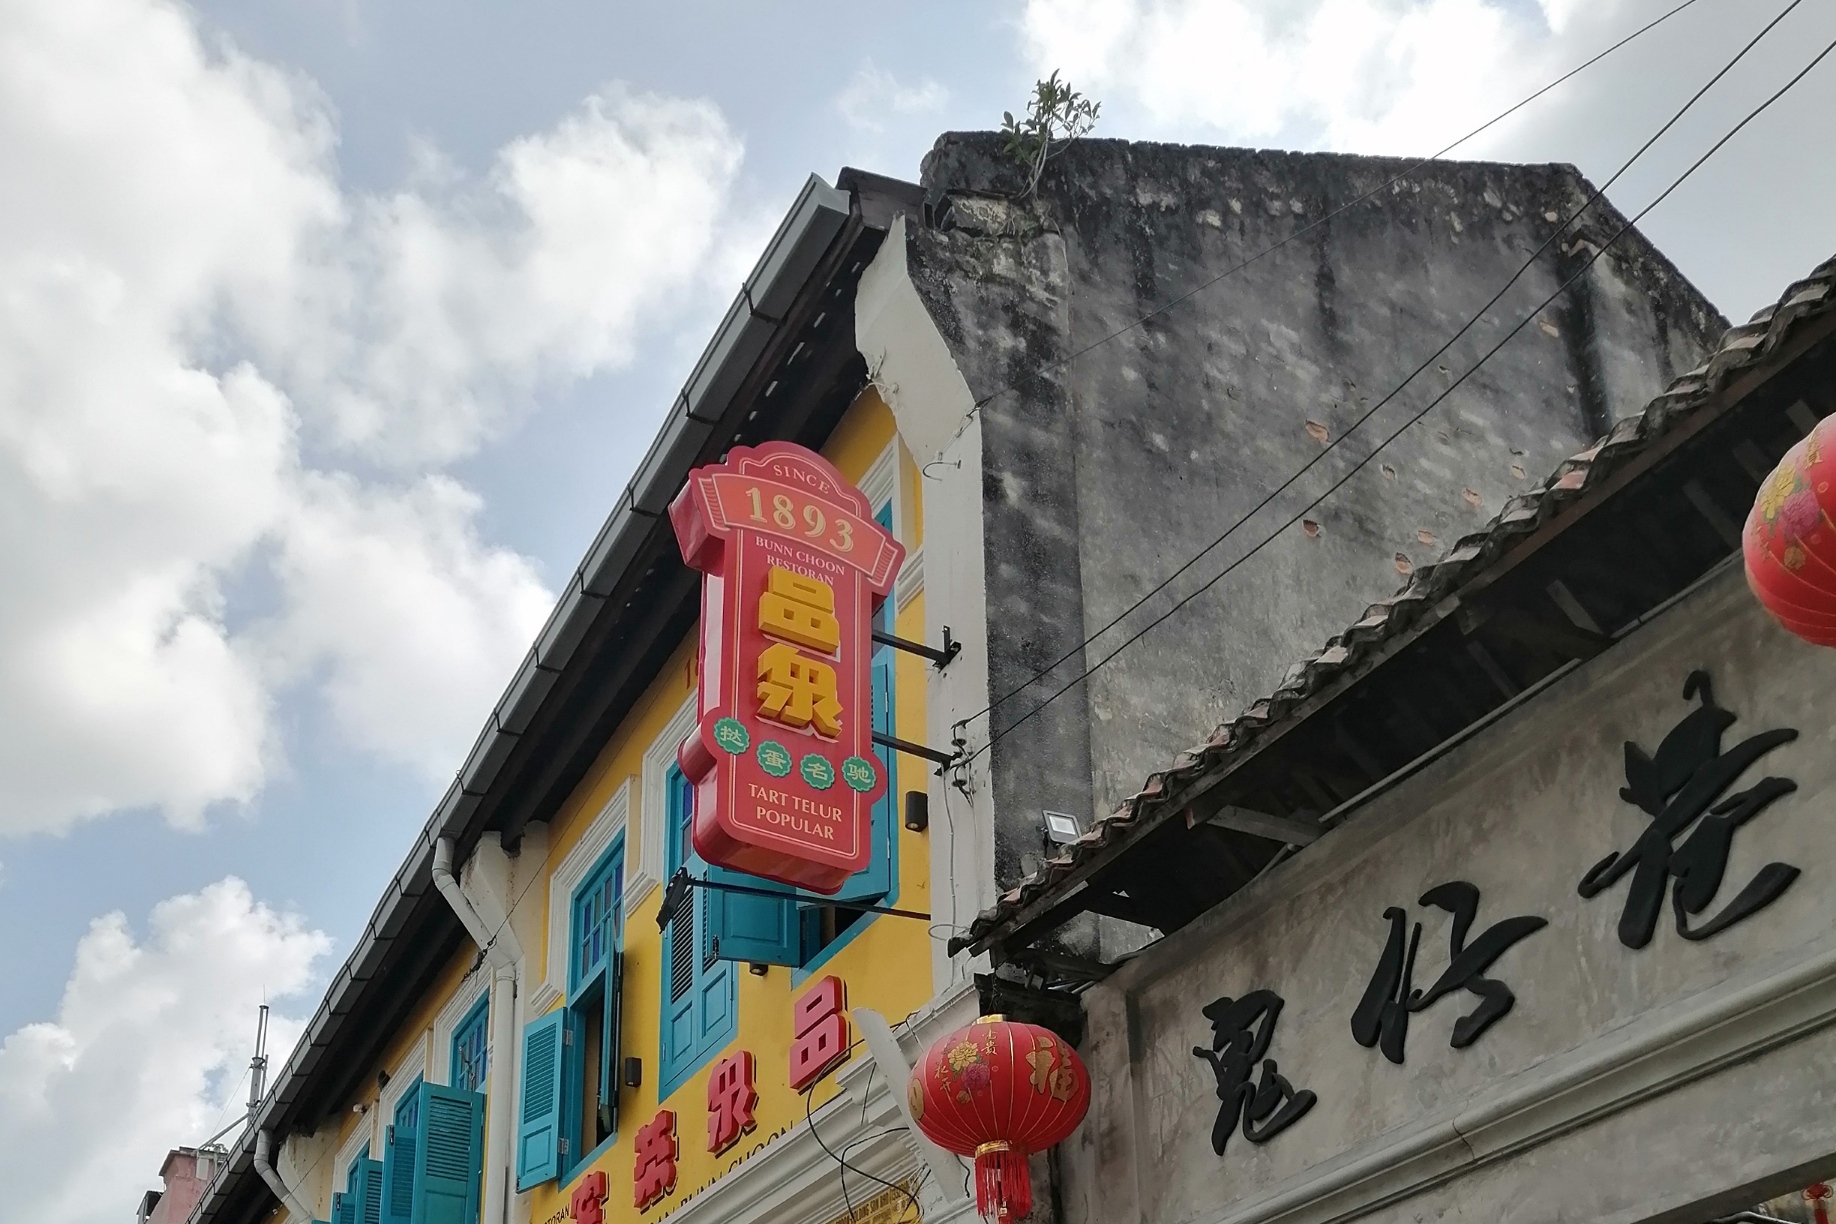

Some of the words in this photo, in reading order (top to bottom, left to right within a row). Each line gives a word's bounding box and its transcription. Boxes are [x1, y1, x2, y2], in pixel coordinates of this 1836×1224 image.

[773, 464, 830, 494] SINCE
[745, 486, 854, 553] 1893
[755, 536, 793, 557] BUNN
[796, 551, 845, 575] CHOON
[767, 554, 834, 586] RESTORAN
[749, 783, 788, 806] TART
[792, 796, 842, 822] TELUR
[756, 806, 834, 840] POPULAR
